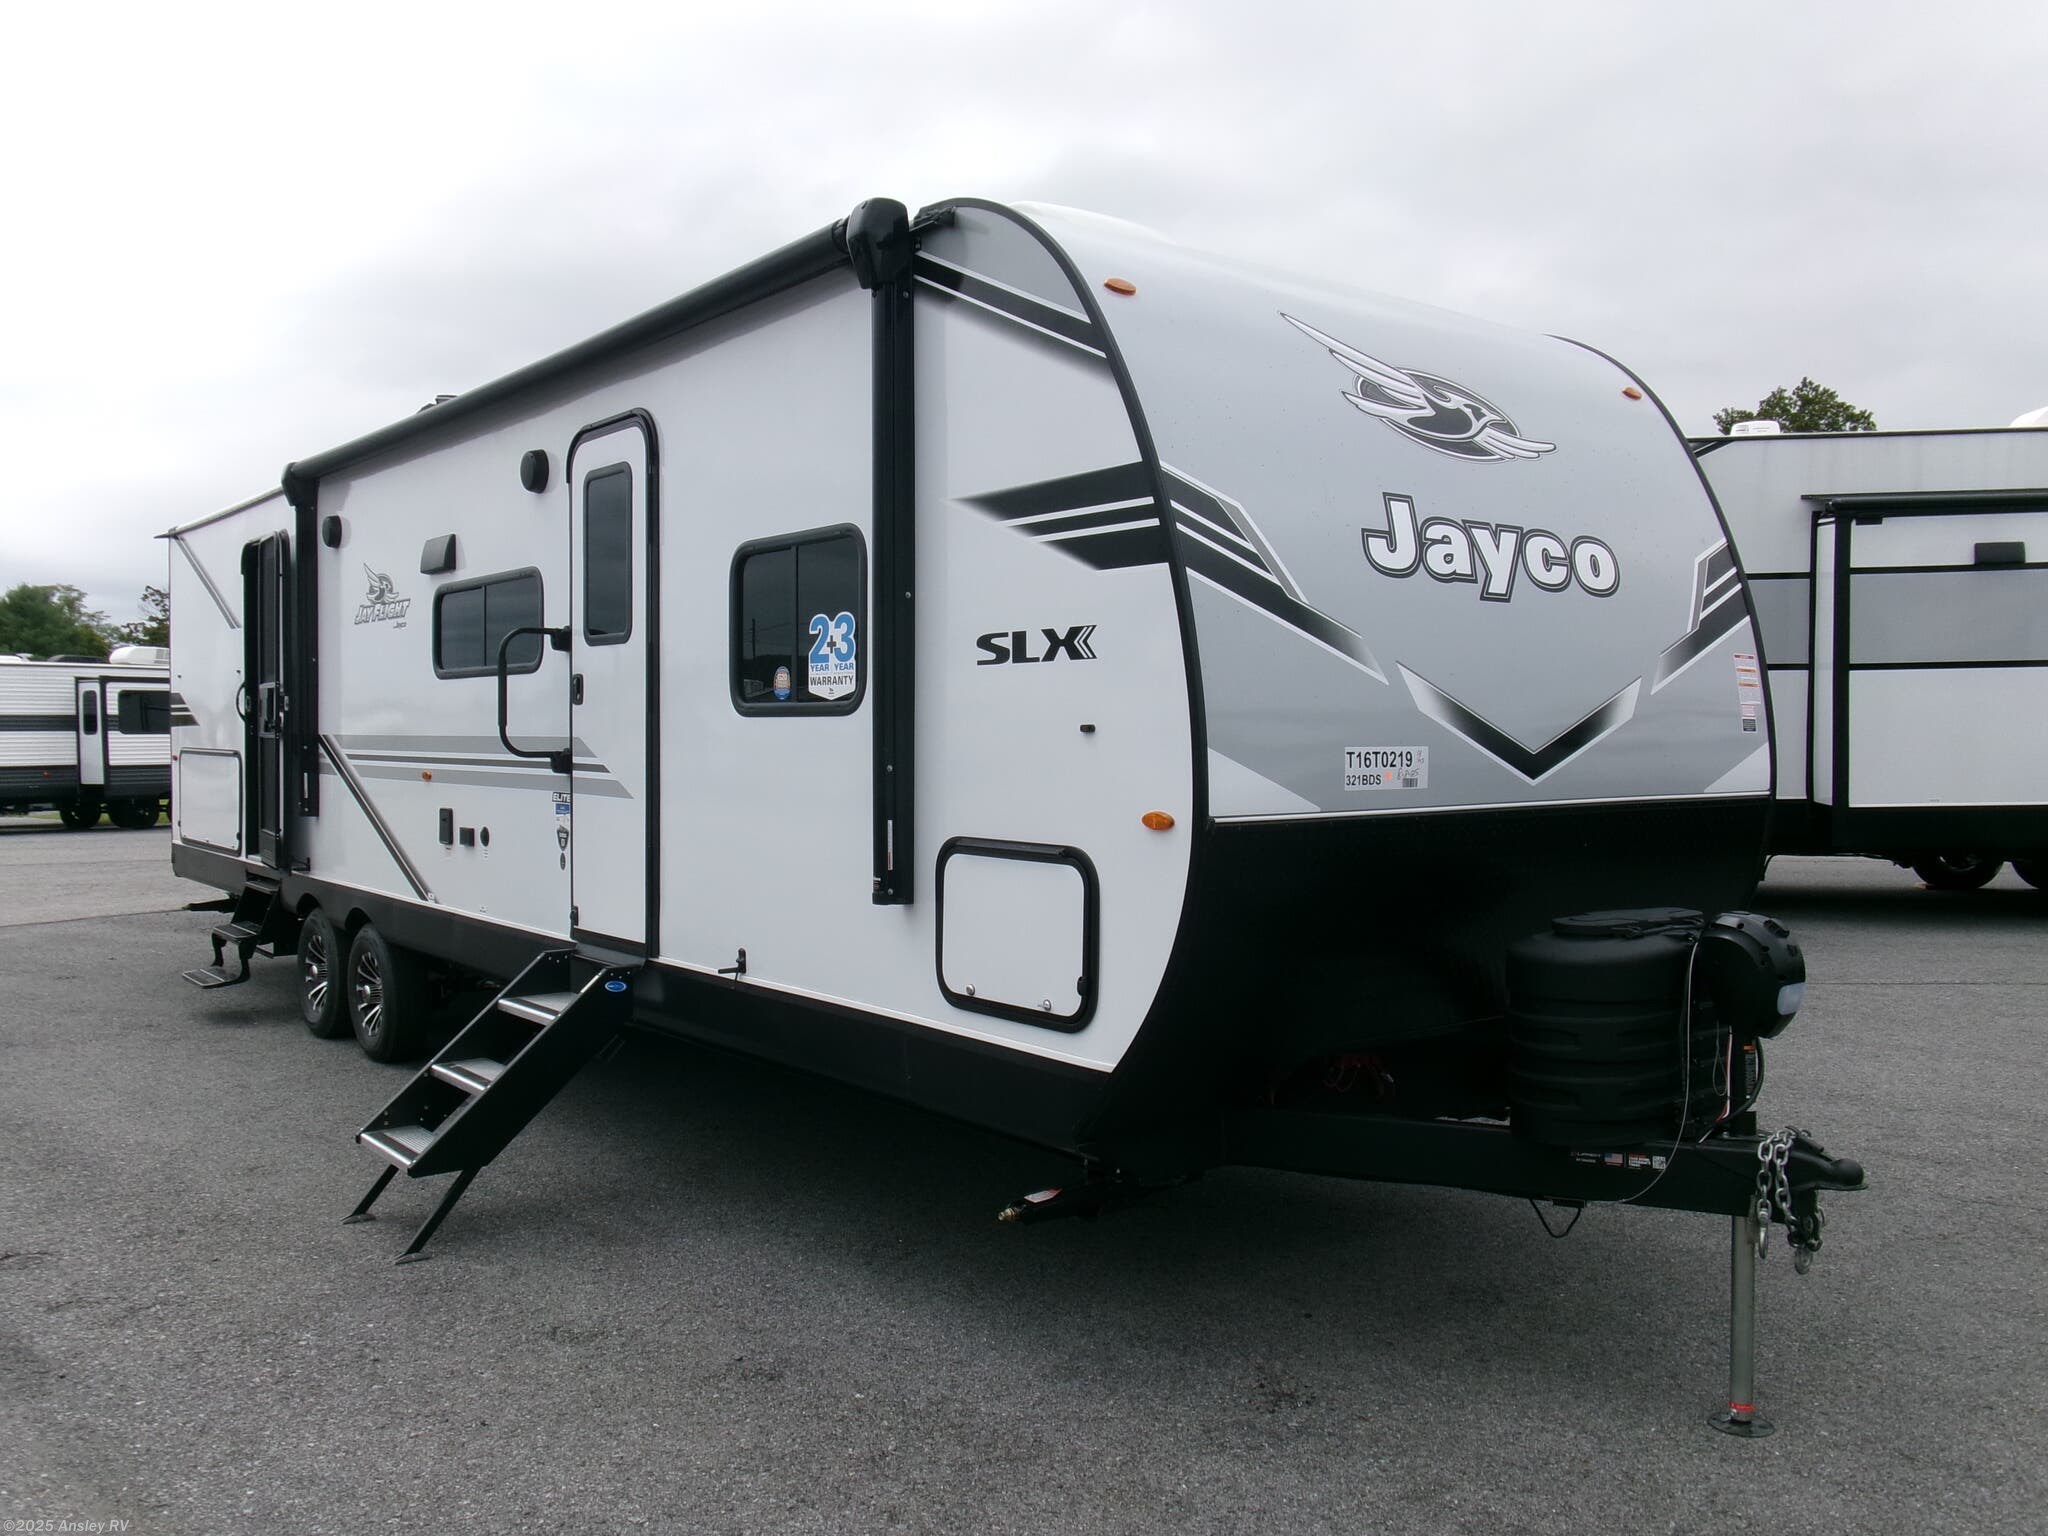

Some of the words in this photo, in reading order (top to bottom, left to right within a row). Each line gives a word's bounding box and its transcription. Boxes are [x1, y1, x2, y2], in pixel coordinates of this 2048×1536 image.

[1361, 491, 1620, 603] Jayco
[354, 604, 377, 625] JAY
[372, 598, 411, 621] FLIGHT
[976, 624, 1097, 665] SLX
[810, 664, 830, 672] YEAR
[834, 662, 854, 671] YEAR
[810, 675, 854, 686] WARRANTY
[1346, 751, 1413, 768] T16T0219
[1346, 774, 1382, 786] 321BDS
